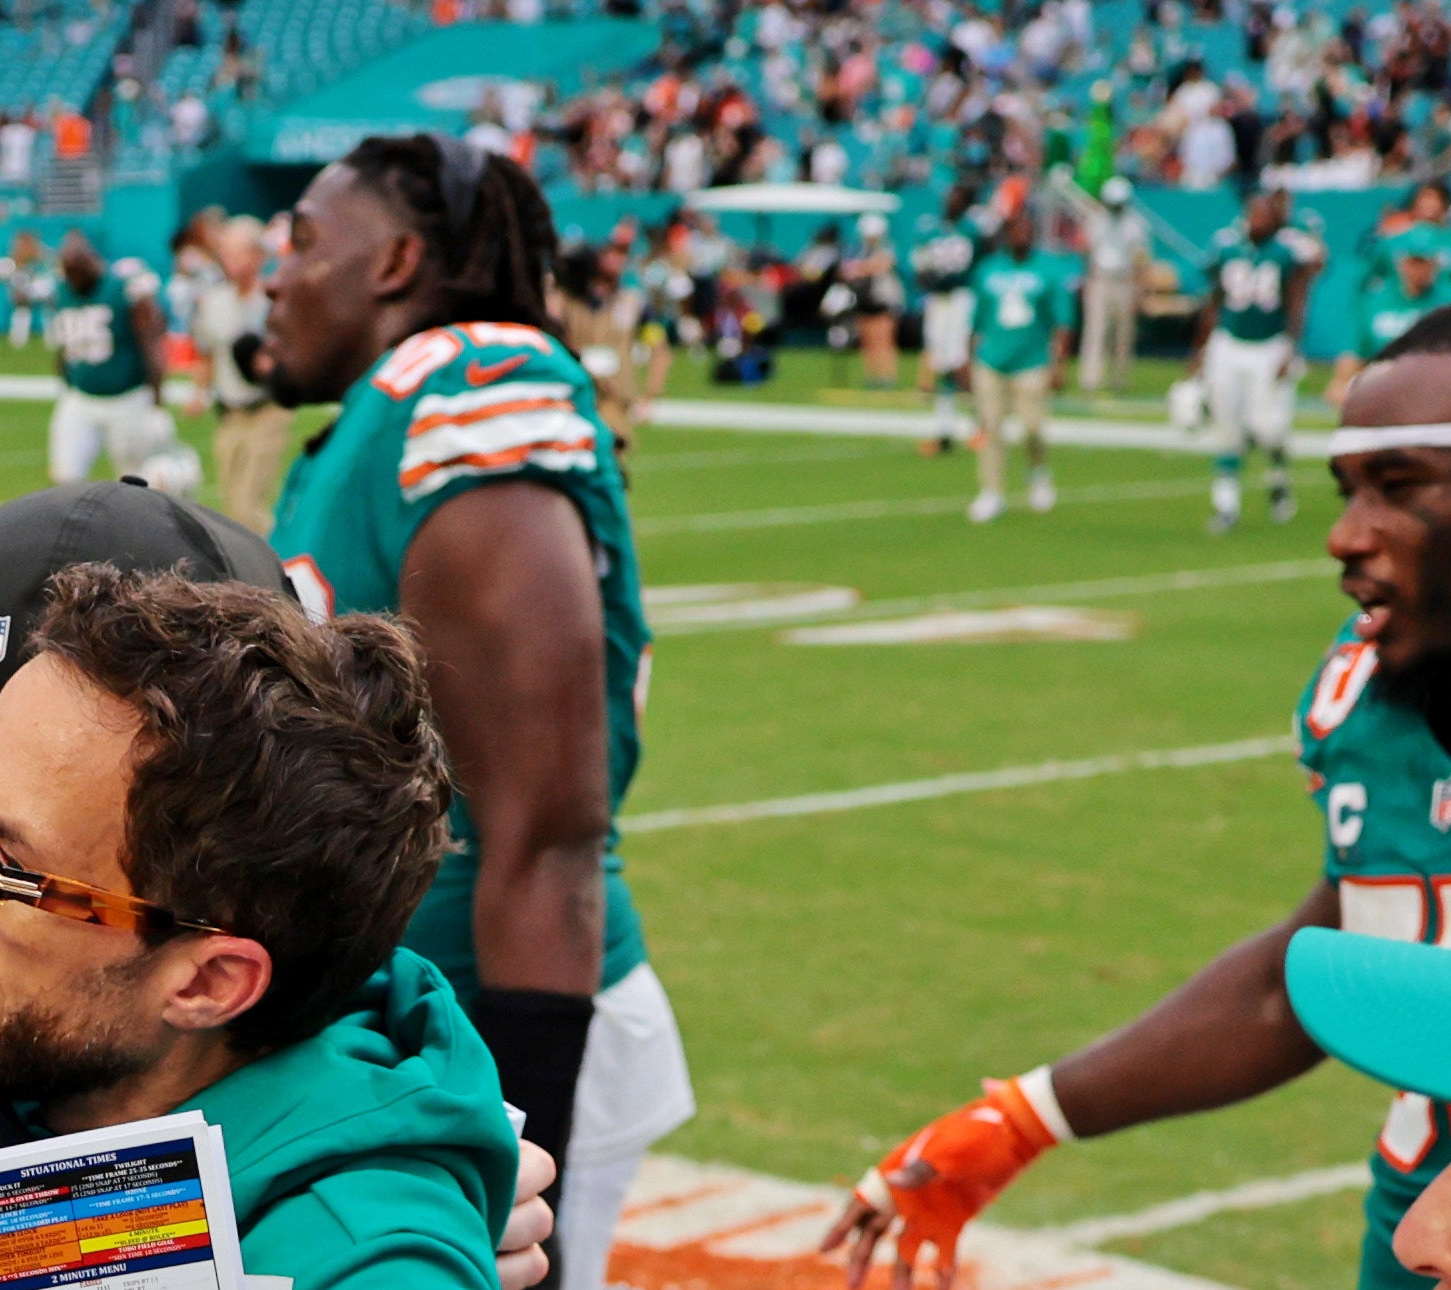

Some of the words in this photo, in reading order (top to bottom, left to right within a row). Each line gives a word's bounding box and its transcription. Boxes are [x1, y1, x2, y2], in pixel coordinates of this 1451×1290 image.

[1327, 783, 1367, 848] C
[20, 1158, 85, 1177] SITUATIONAL
[86, 1152, 117, 1165] TIMES
[114, 1158, 147, 1169] TWILIGHT
[105, 1169, 127, 1178] FRAME
[95, 1179, 112, 1187] SNAP
[96, 1186, 113, 1194] SNAP
[15, 1193, 34, 1202] OVER
[34, 1188, 59, 1198] THROW
[16, 1219, 50, 1230] EXTENDED
[51, 1215, 68, 1223] PLAY
[51, 1275, 58, 1284] 2
[59, 1268, 97, 1282] MINUTE
[98, 1262, 126, 1275] MENU
